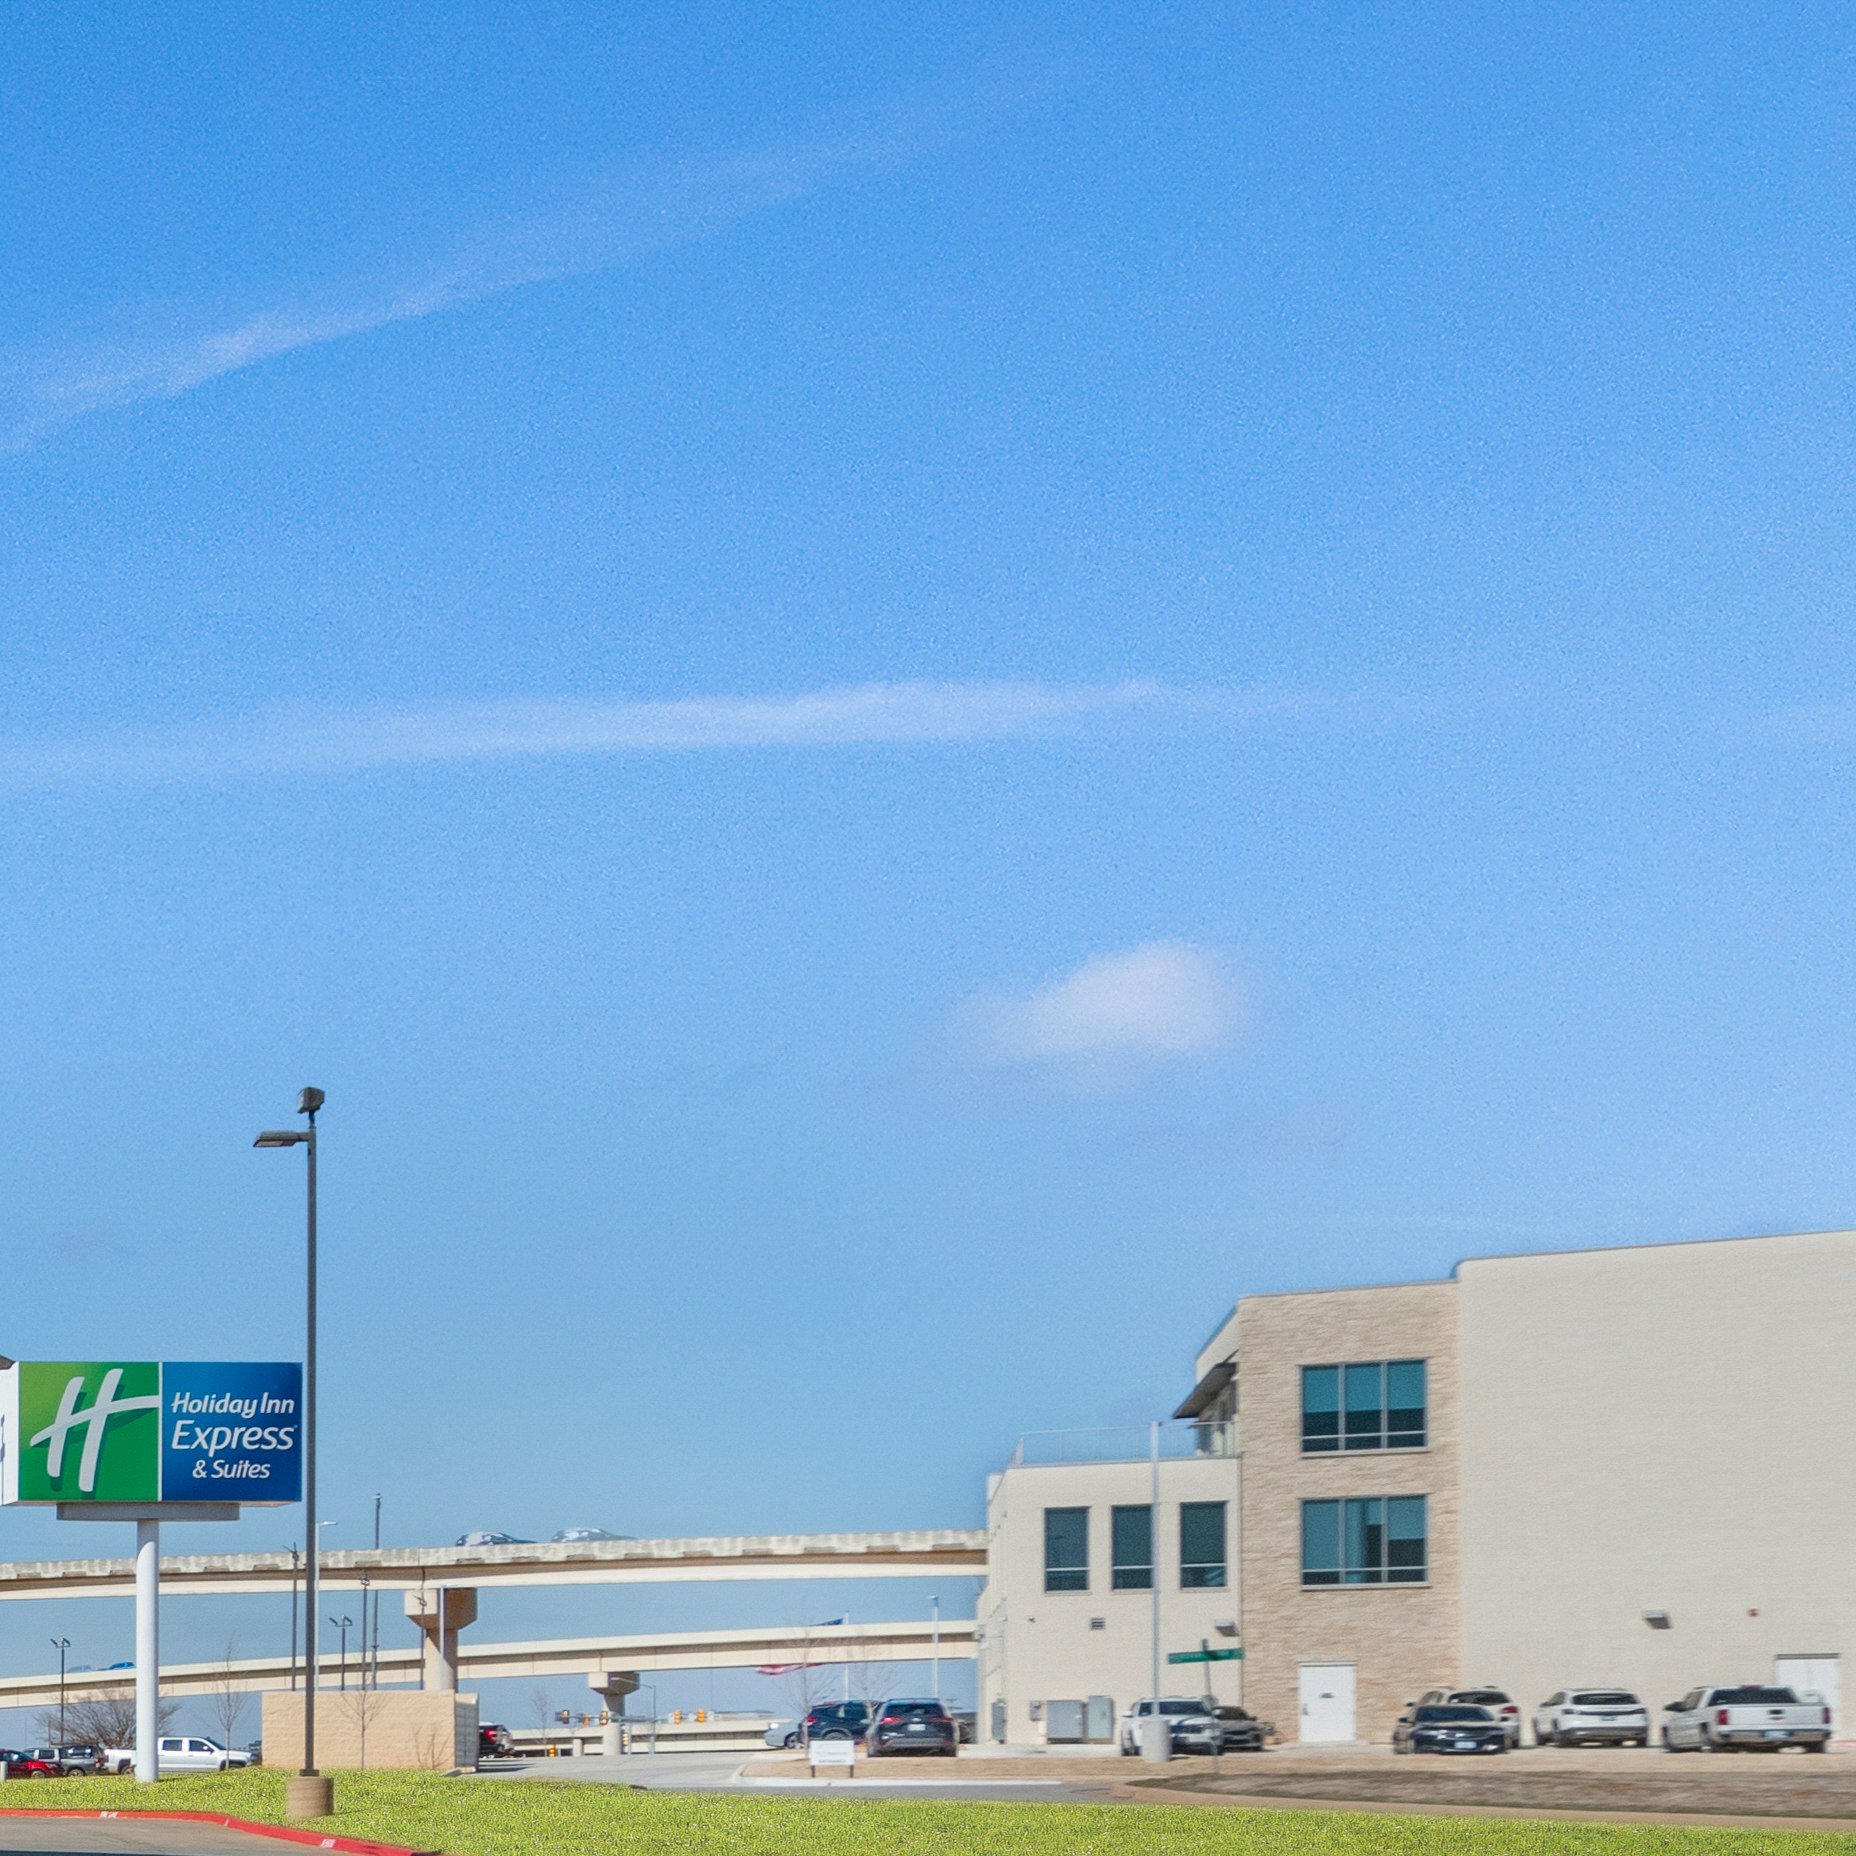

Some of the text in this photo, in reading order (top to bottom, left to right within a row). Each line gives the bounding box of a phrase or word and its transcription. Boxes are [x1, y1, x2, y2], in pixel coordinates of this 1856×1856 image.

[171, 1392, 295, 1419] Holiday Inn
[171, 1419, 295, 1458] Express
[192, 1459, 271, 1479] & Suites
